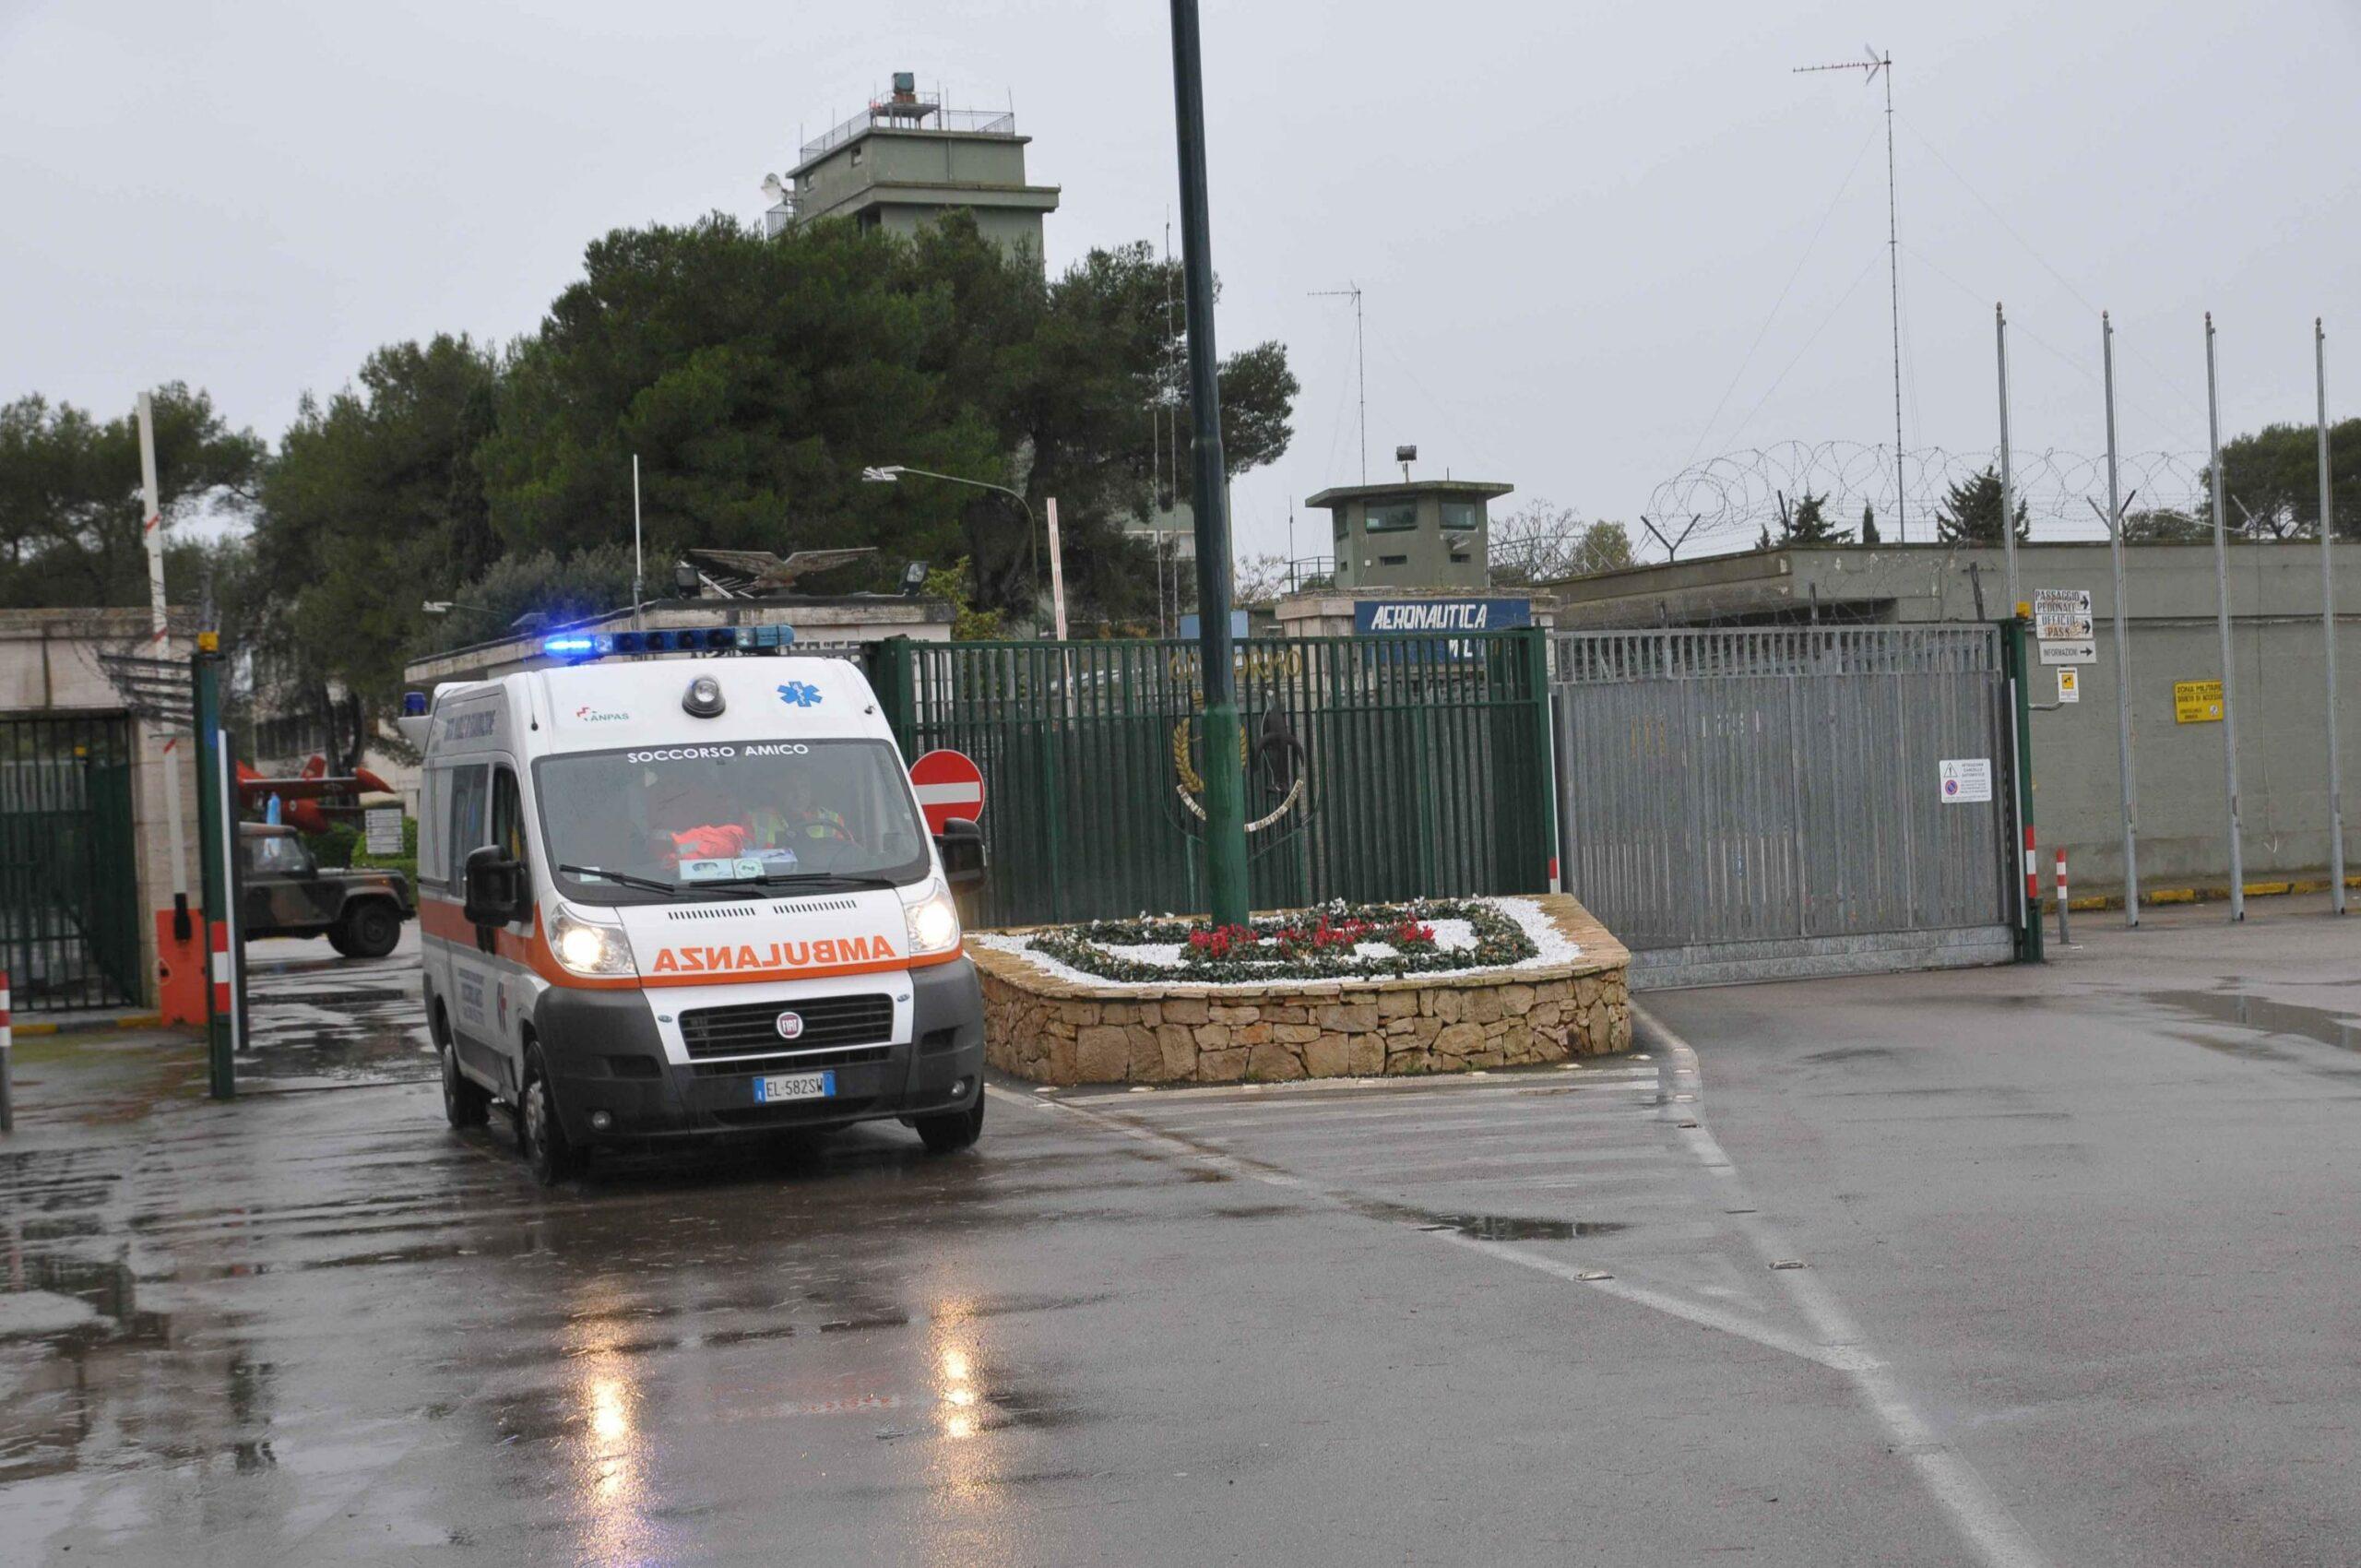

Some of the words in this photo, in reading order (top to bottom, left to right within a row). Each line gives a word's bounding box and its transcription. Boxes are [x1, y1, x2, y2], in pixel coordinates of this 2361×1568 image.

[1370, 604, 1488, 630] AERONAUTICA
[627, 746, 735, 764] SOCCORSO
[744, 743, 809, 756] AMICO
[782, 1019, 798, 1033] FIAT
